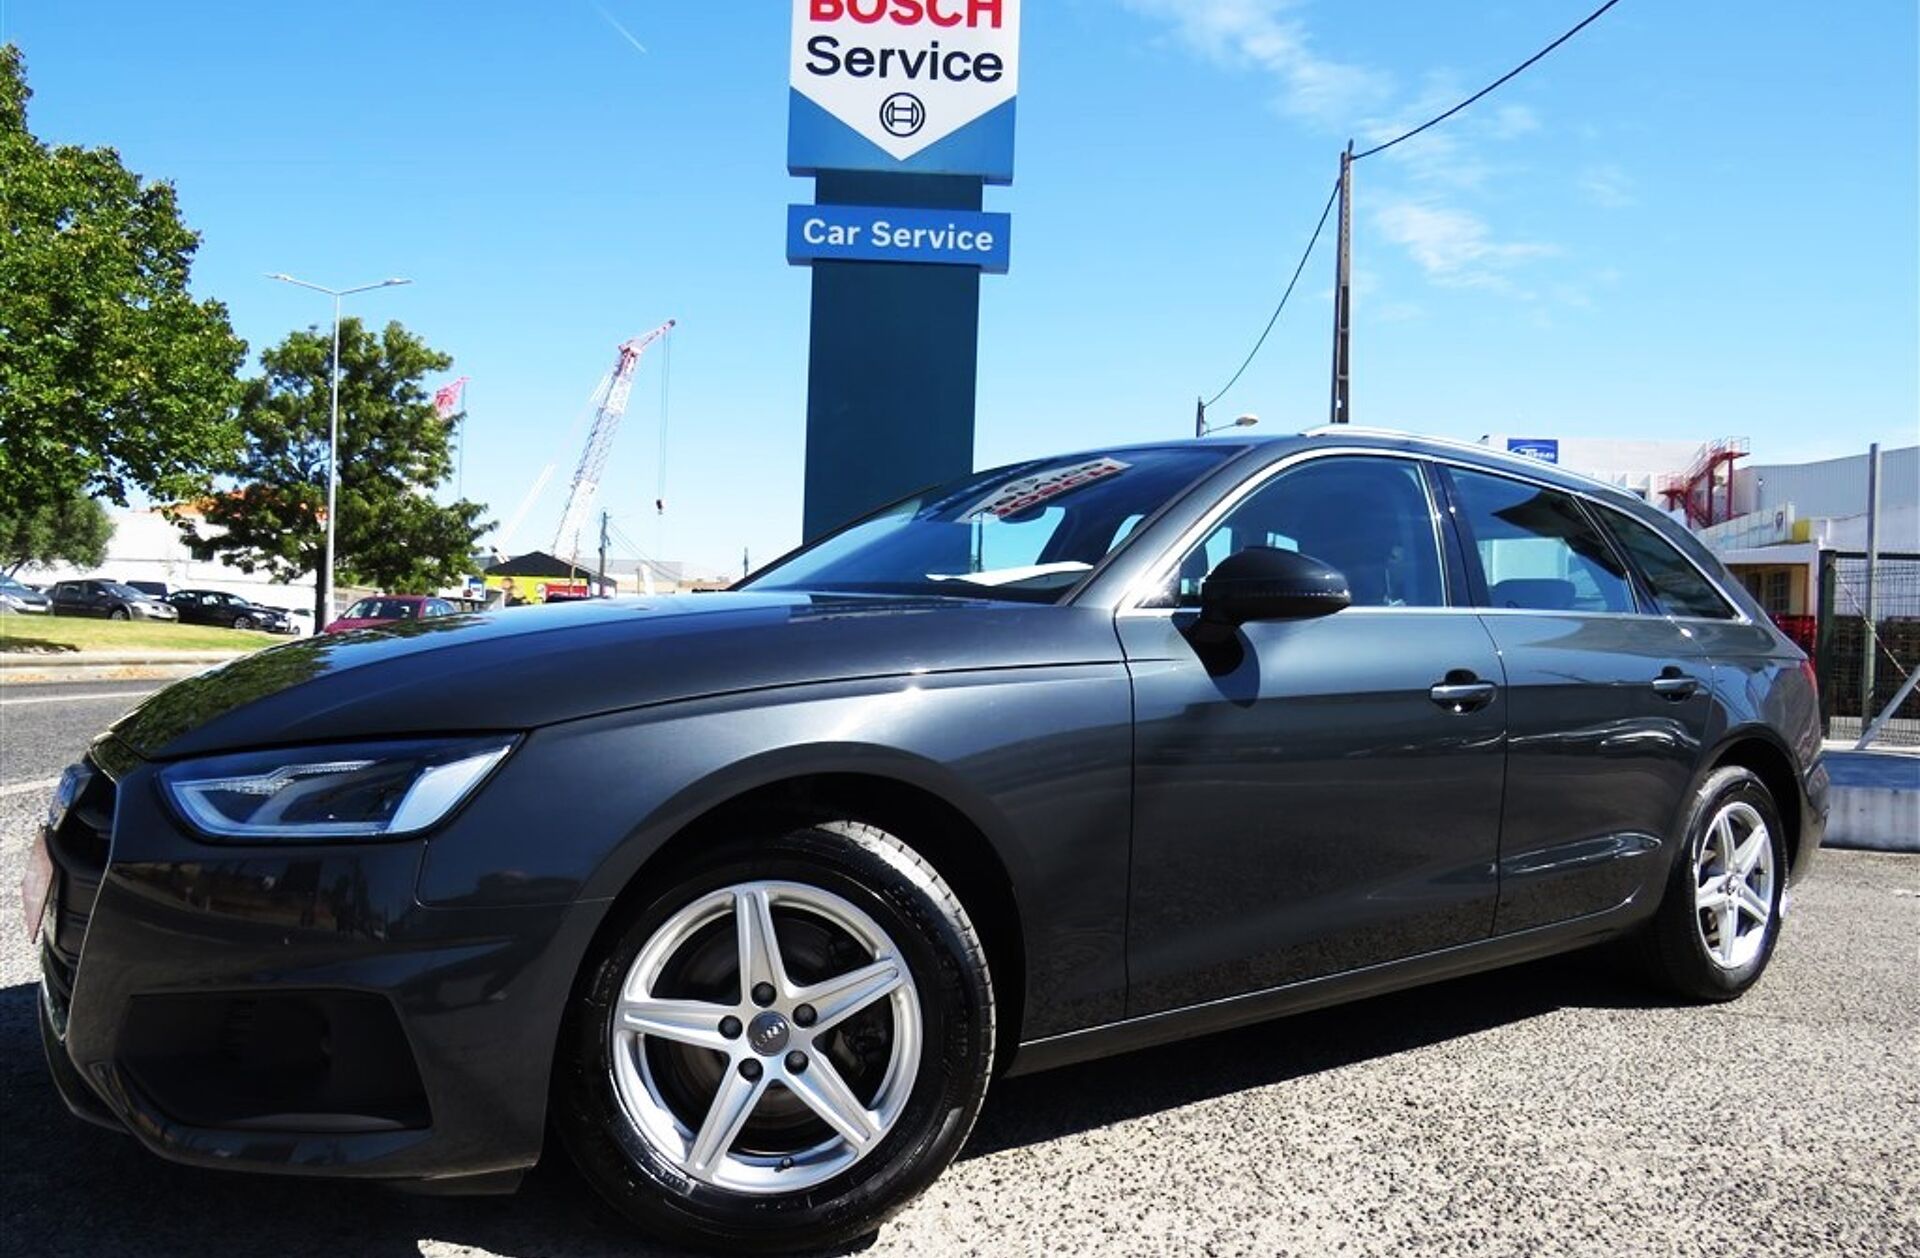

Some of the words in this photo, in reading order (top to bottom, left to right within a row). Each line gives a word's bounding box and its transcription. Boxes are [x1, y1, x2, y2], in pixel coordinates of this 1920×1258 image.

[810, 0, 1002, 28] BOSCH
[805, 35, 1003, 83] Service
[803, 218, 861, 246] Car
[871, 221, 993, 251] Service
